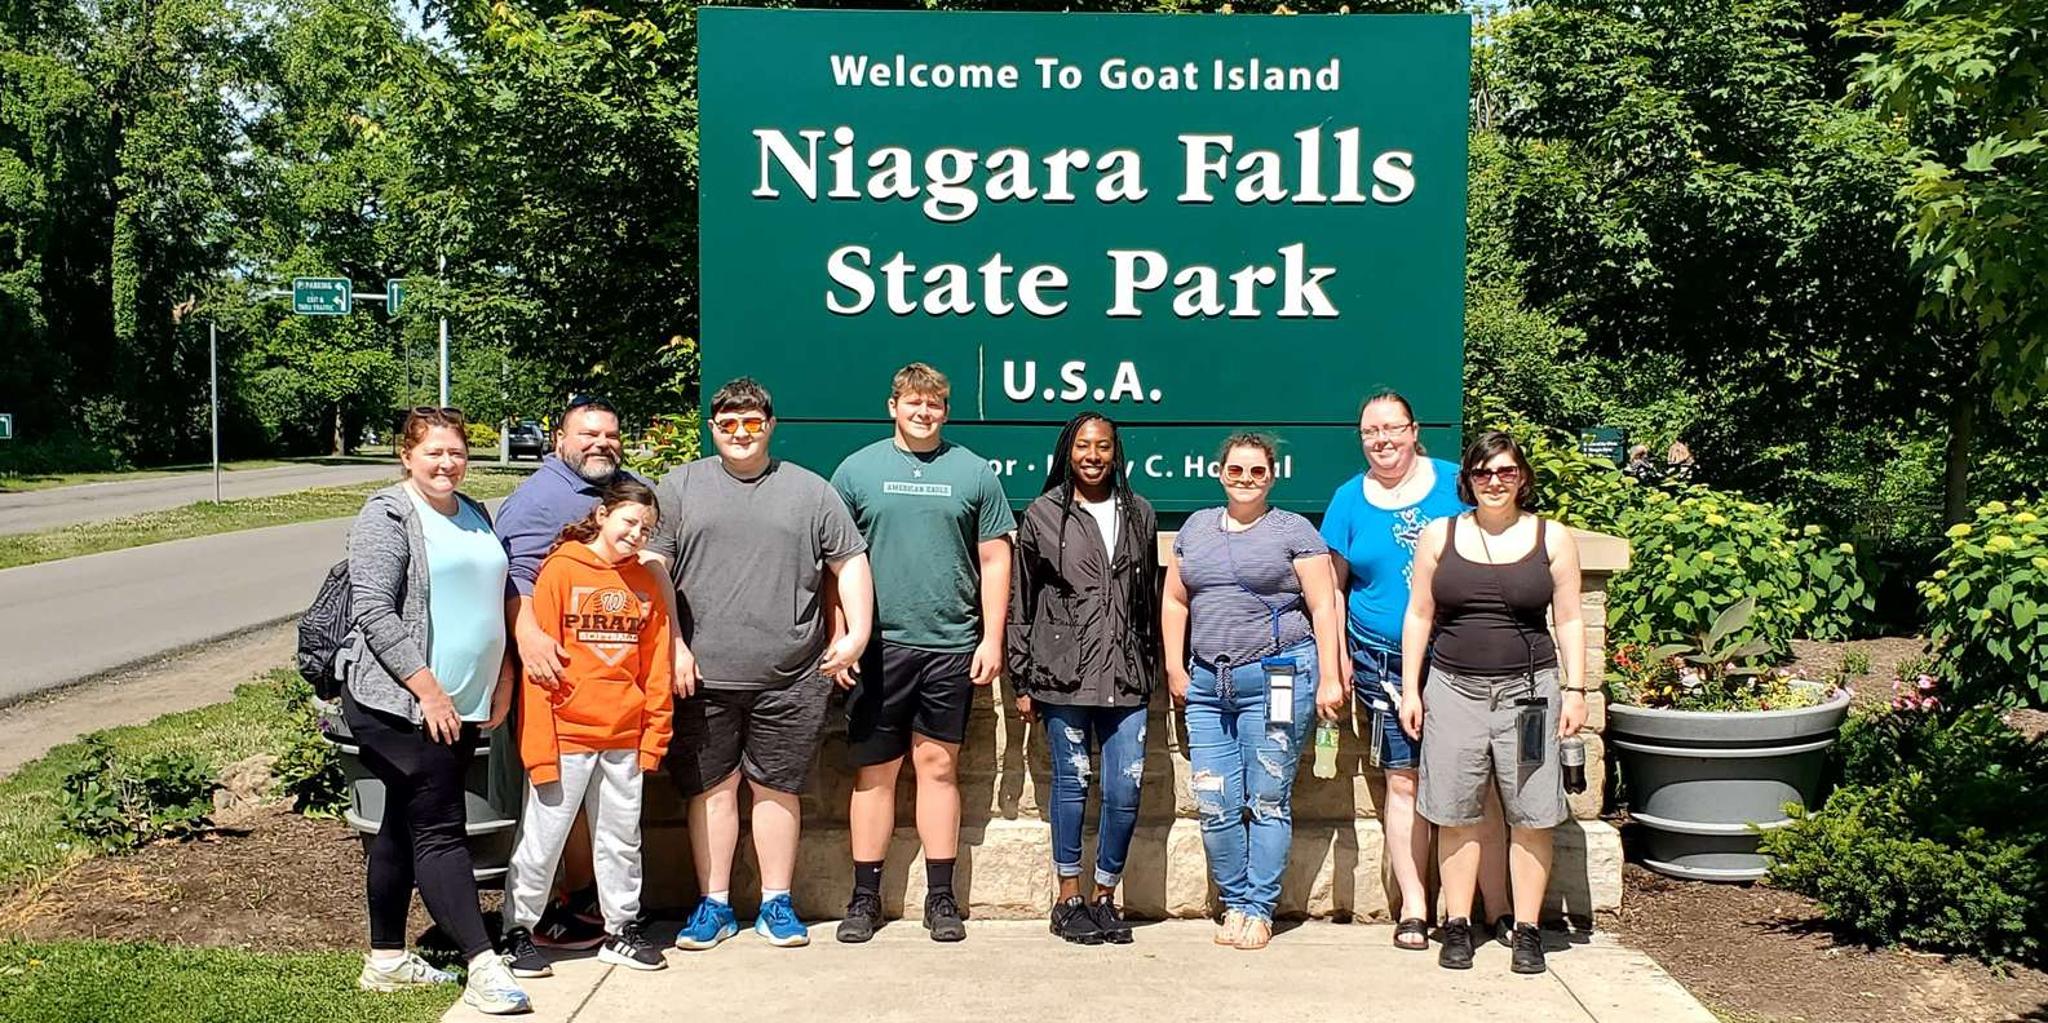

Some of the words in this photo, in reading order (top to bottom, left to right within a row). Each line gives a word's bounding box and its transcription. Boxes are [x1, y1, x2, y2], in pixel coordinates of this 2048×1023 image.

[829, 54, 1018, 89] Welcome
[1035, 58, 1082, 89] To
[1100, 58, 1199, 90] Goat
[1214, 57, 1340, 91] Island
[751, 126, 1149, 222] Niagara
[1177, 126, 1416, 204] Falls
[305, 281, 332, 290] PARKING
[825, 244, 1069, 317] State
[1106, 242, 1340, 317] Park
[1003, 360, 1163, 403] U.S.A.
[1145, 455, 1173, 477] C.
[886, 484, 924, 493] AMERICAN
[925, 486, 950, 494] EAGLE
[564, 614, 646, 633] PIRAT
